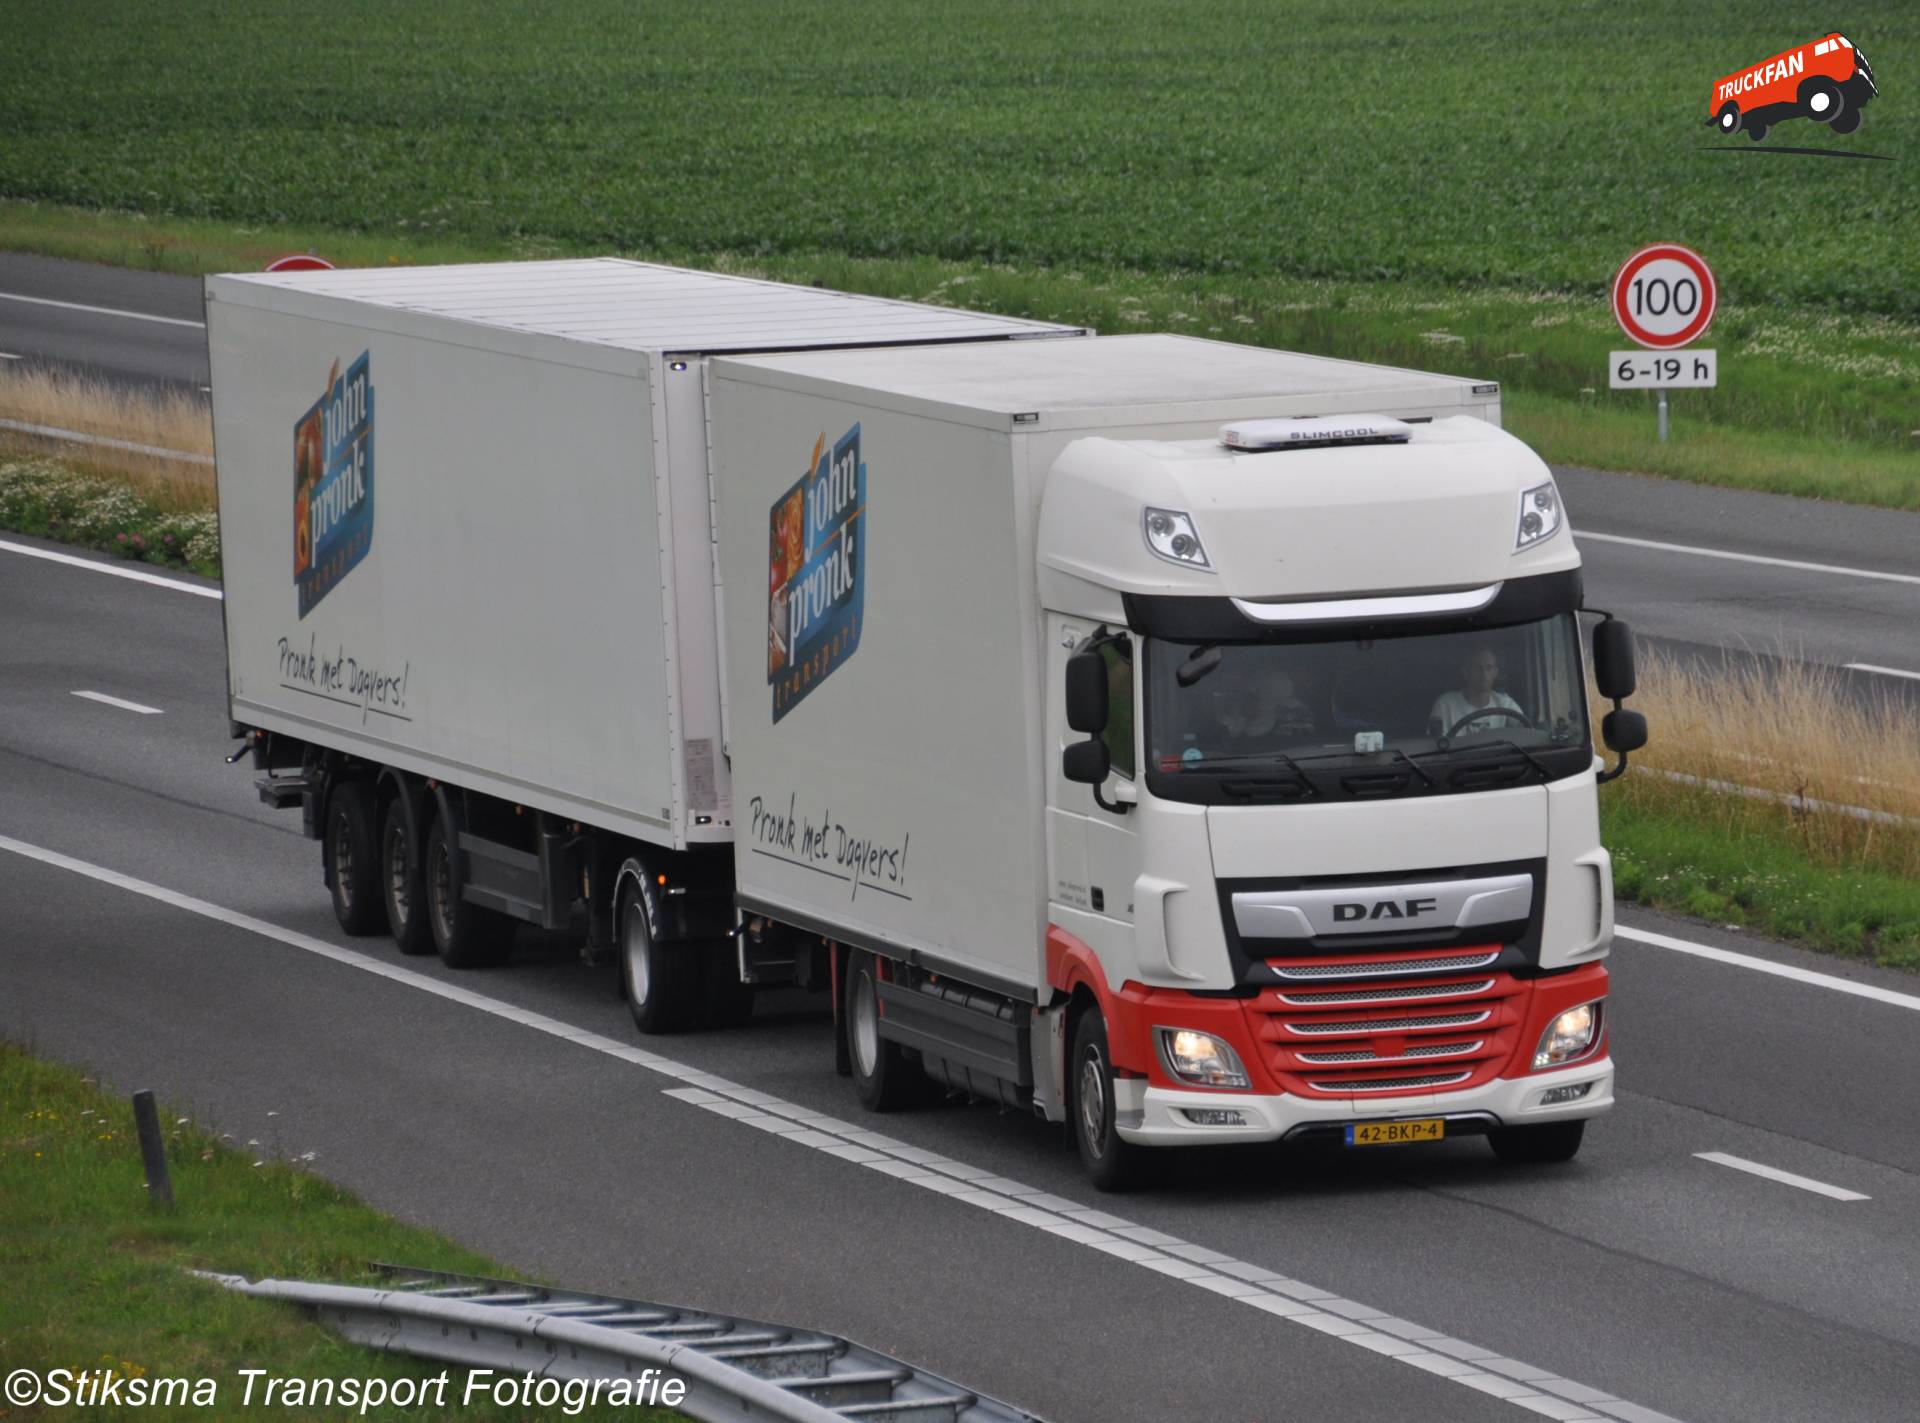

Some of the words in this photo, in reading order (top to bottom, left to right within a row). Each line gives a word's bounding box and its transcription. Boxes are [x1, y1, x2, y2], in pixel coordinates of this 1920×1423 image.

[1633, 278, 1697, 316] 100
[1618, 358, 1681, 381] 6-19
[1694, 358, 1708, 380] h
[323, 369, 367, 476] john
[1290, 427, 1379, 440] SLIMCOOL
[311, 439, 365, 569] pronk
[804, 447, 856, 563] john
[789, 519, 853, 667] pronk
[278, 631, 316, 686] Pronk
[320, 644, 344, 692] met
[750, 792, 796, 854] Pronk
[802, 808, 830, 862] met
[1333, 898, 1437, 922] DAF
[1360, 1123, 1437, 1141] 42-BKP-4
